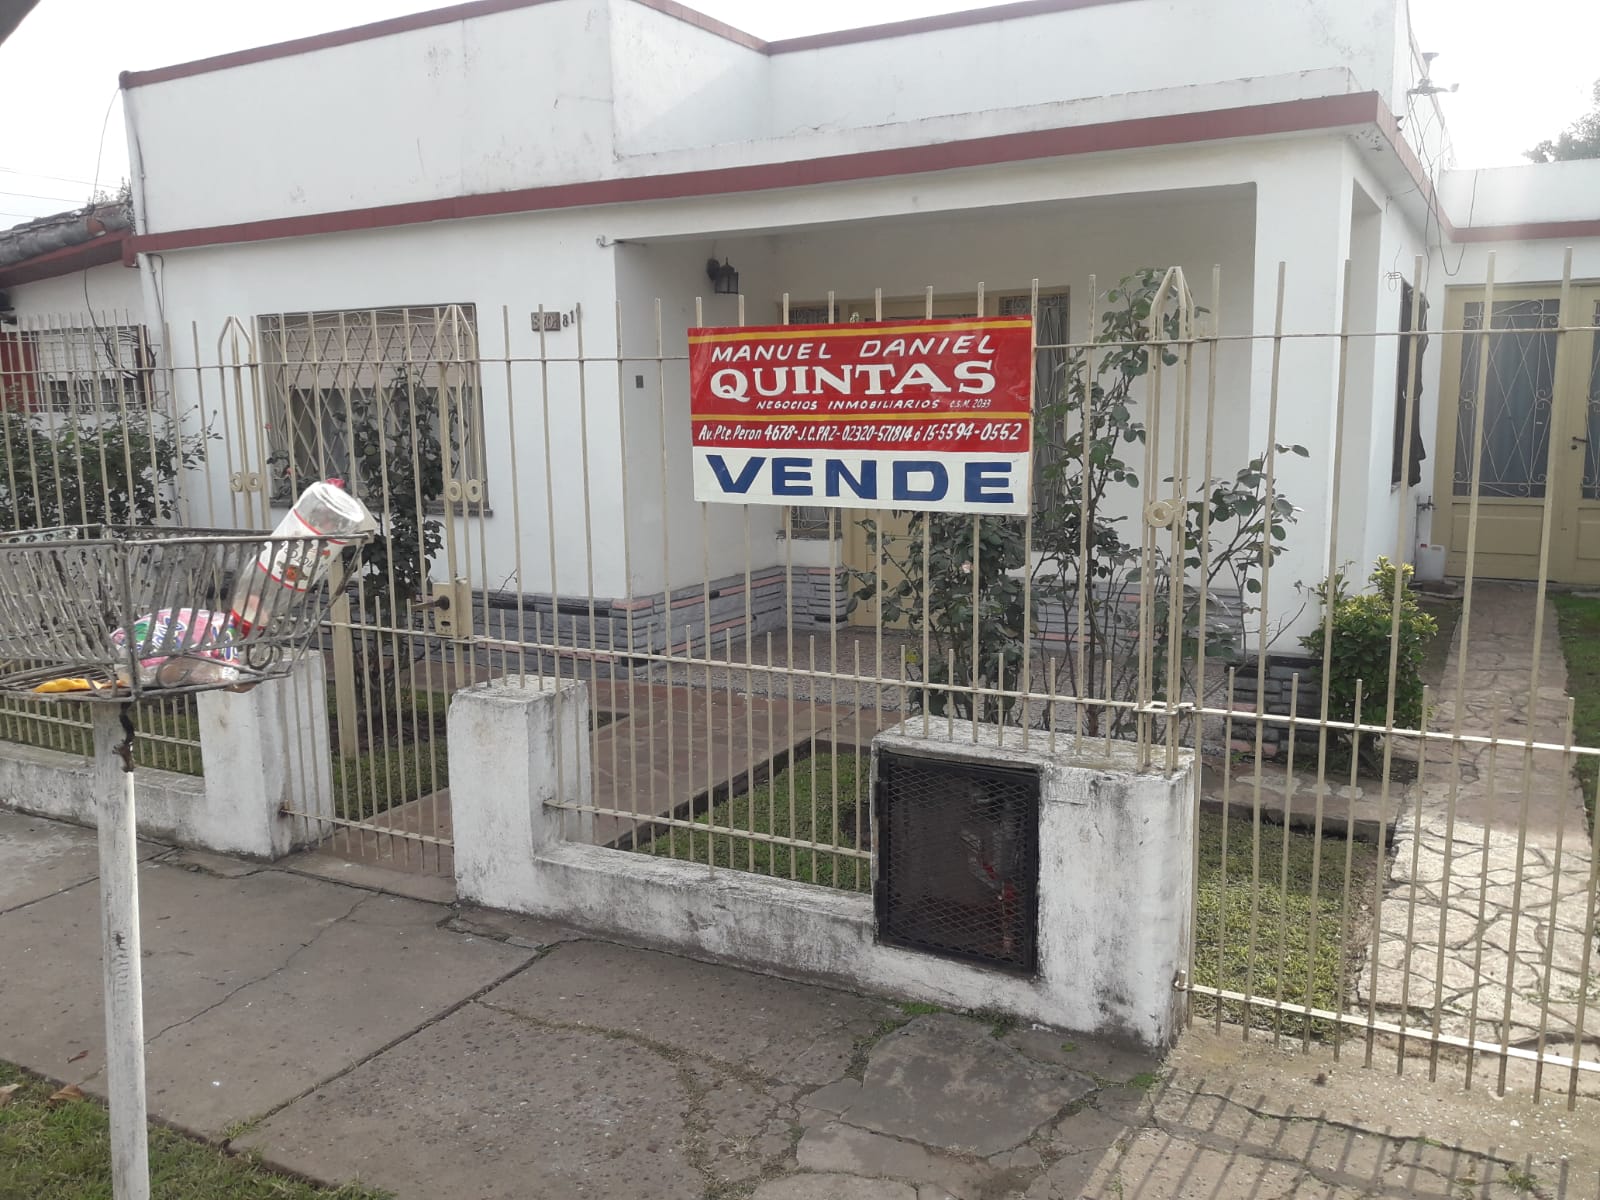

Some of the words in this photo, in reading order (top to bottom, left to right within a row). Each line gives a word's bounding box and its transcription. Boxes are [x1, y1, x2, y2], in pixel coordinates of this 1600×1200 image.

[711, 343, 832, 362] MANUEL
[859, 335, 995, 358] DANIEL
[709, 360, 996, 403] QUINTAS
[756, 400, 818, 410] NEGOCIOS
[828, 399, 941, 410] INMOBILIARIOS
[705, 454, 1015, 504] VENDE
